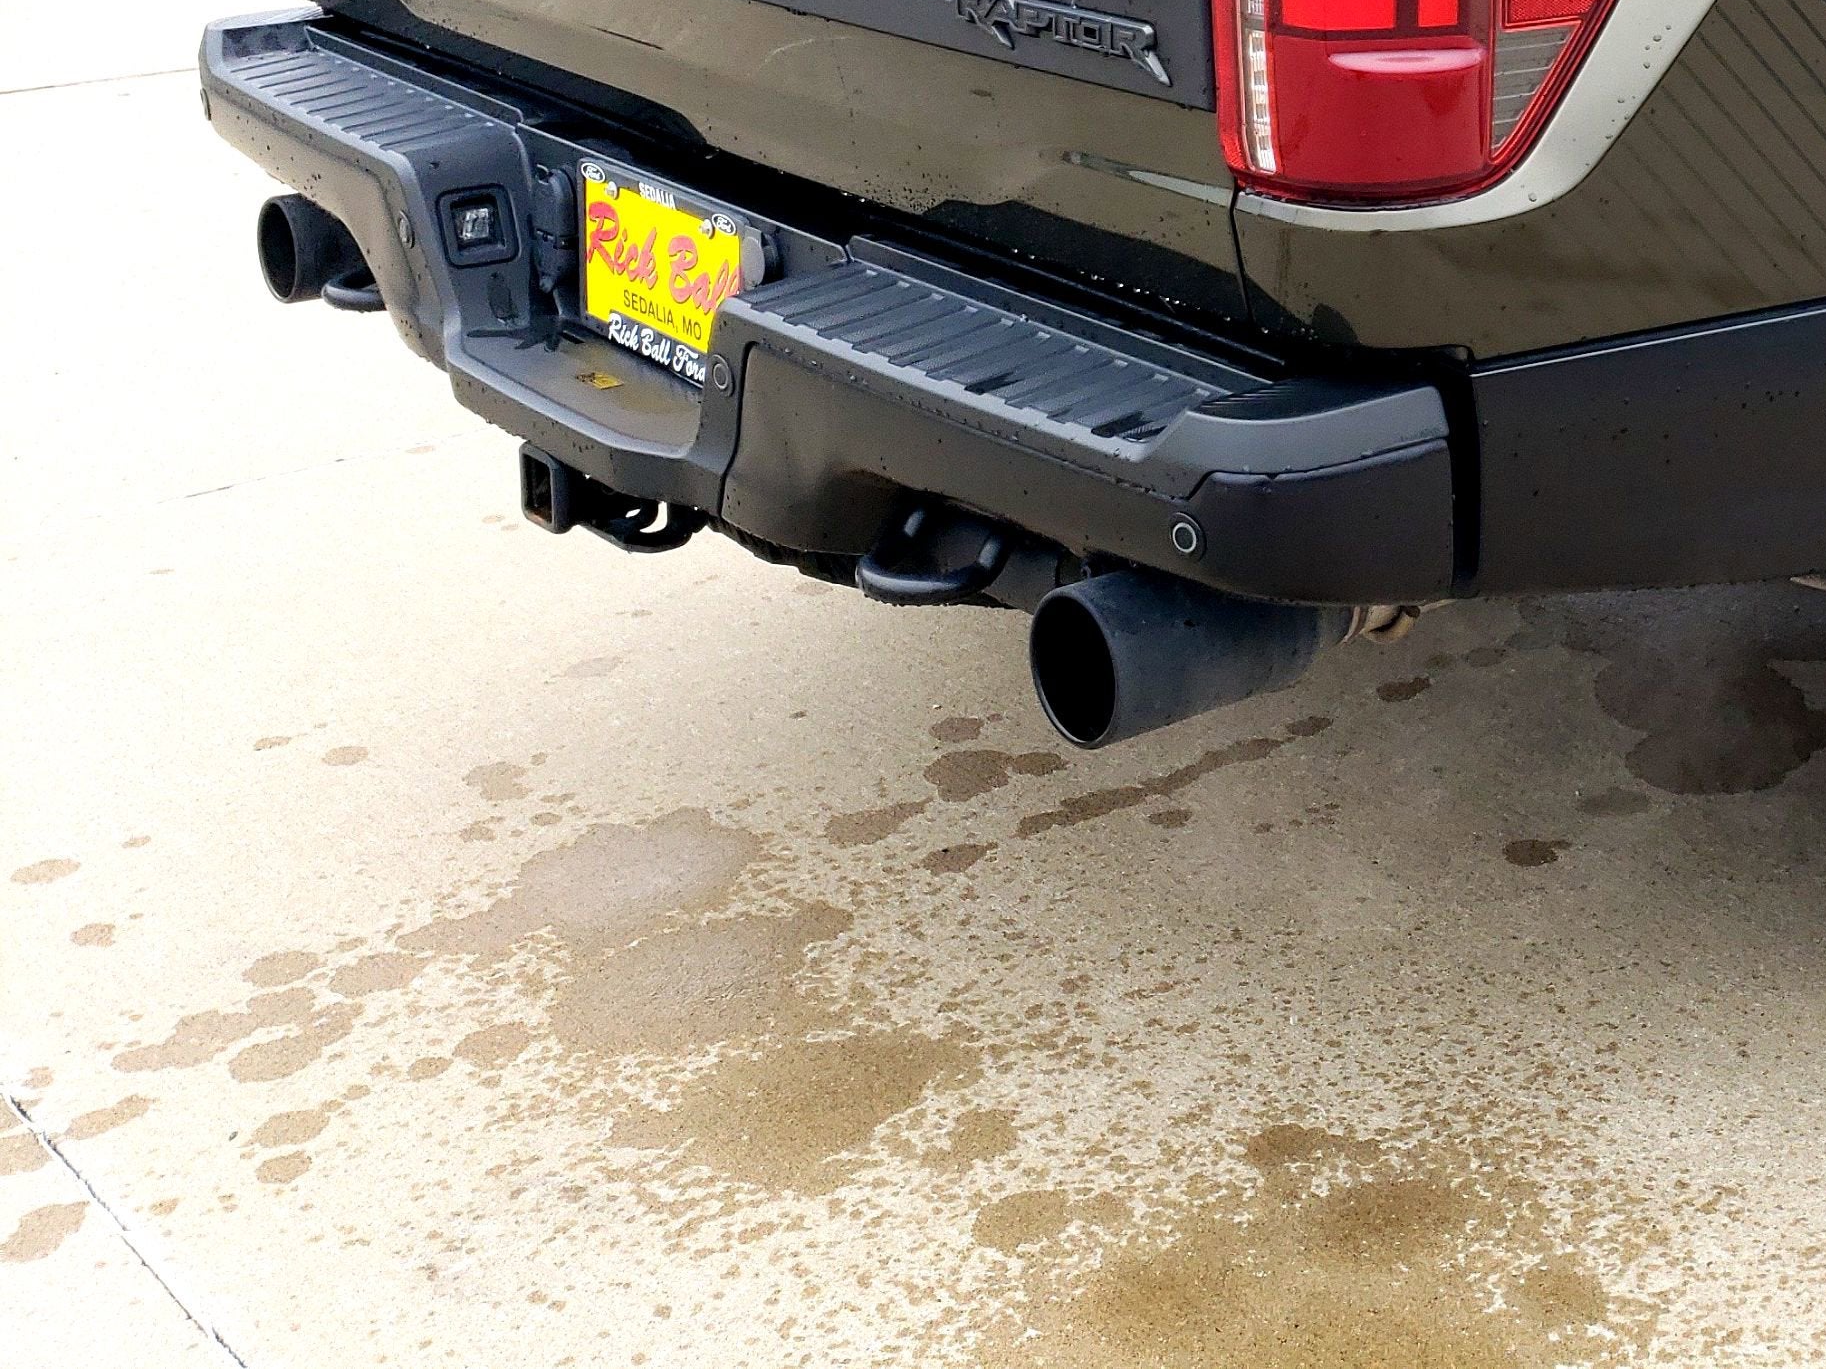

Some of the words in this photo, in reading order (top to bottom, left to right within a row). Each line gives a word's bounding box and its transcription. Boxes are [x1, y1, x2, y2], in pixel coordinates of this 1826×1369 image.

[638, 182, 677, 211] SEDALIA
[586, 200, 659, 290] Rick
[607, 312, 640, 351] Rick
[641, 328, 671, 366] Ball
[623, 289, 679, 333] SEDALIA,
[682, 316, 702, 341] MO
